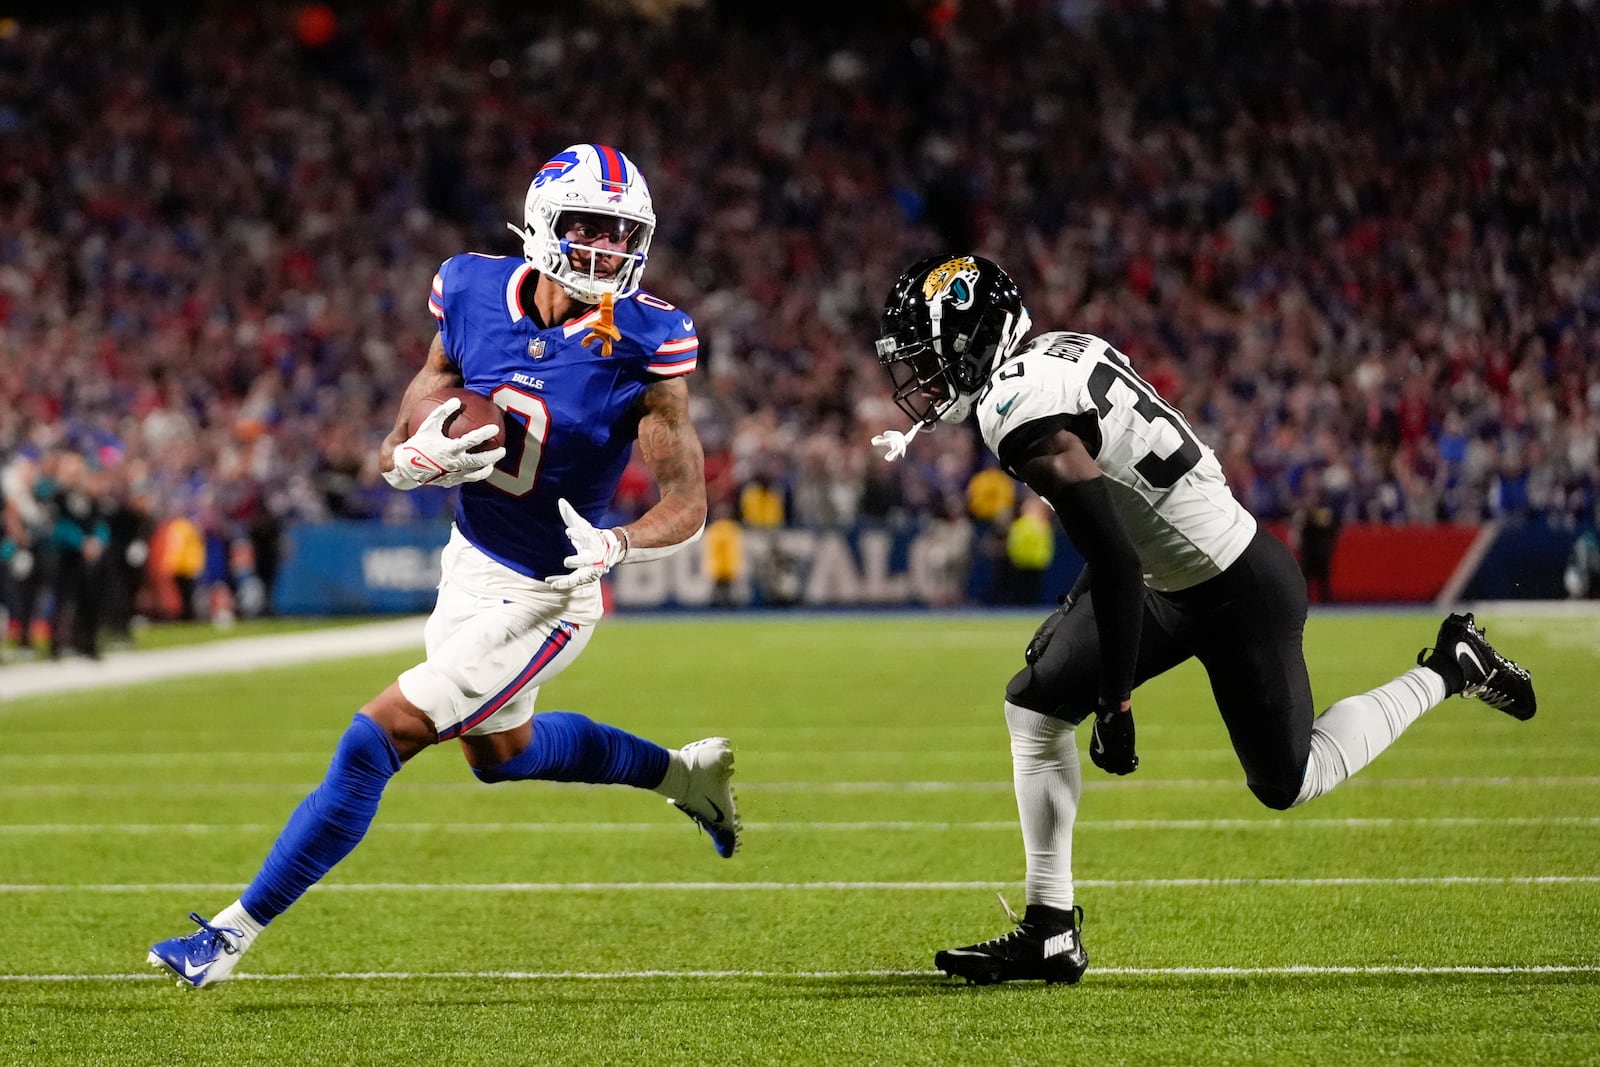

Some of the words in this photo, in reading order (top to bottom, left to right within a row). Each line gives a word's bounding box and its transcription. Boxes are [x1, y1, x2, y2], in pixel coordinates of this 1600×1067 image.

[635, 292, 676, 311] 0
[1043, 335, 1093, 363] BROWN
[511, 372, 544, 389] BILLS
[1087, 347, 1204, 489] 3
[485, 384, 551, 498] 0
[1043, 929, 1075, 960] NIKE
